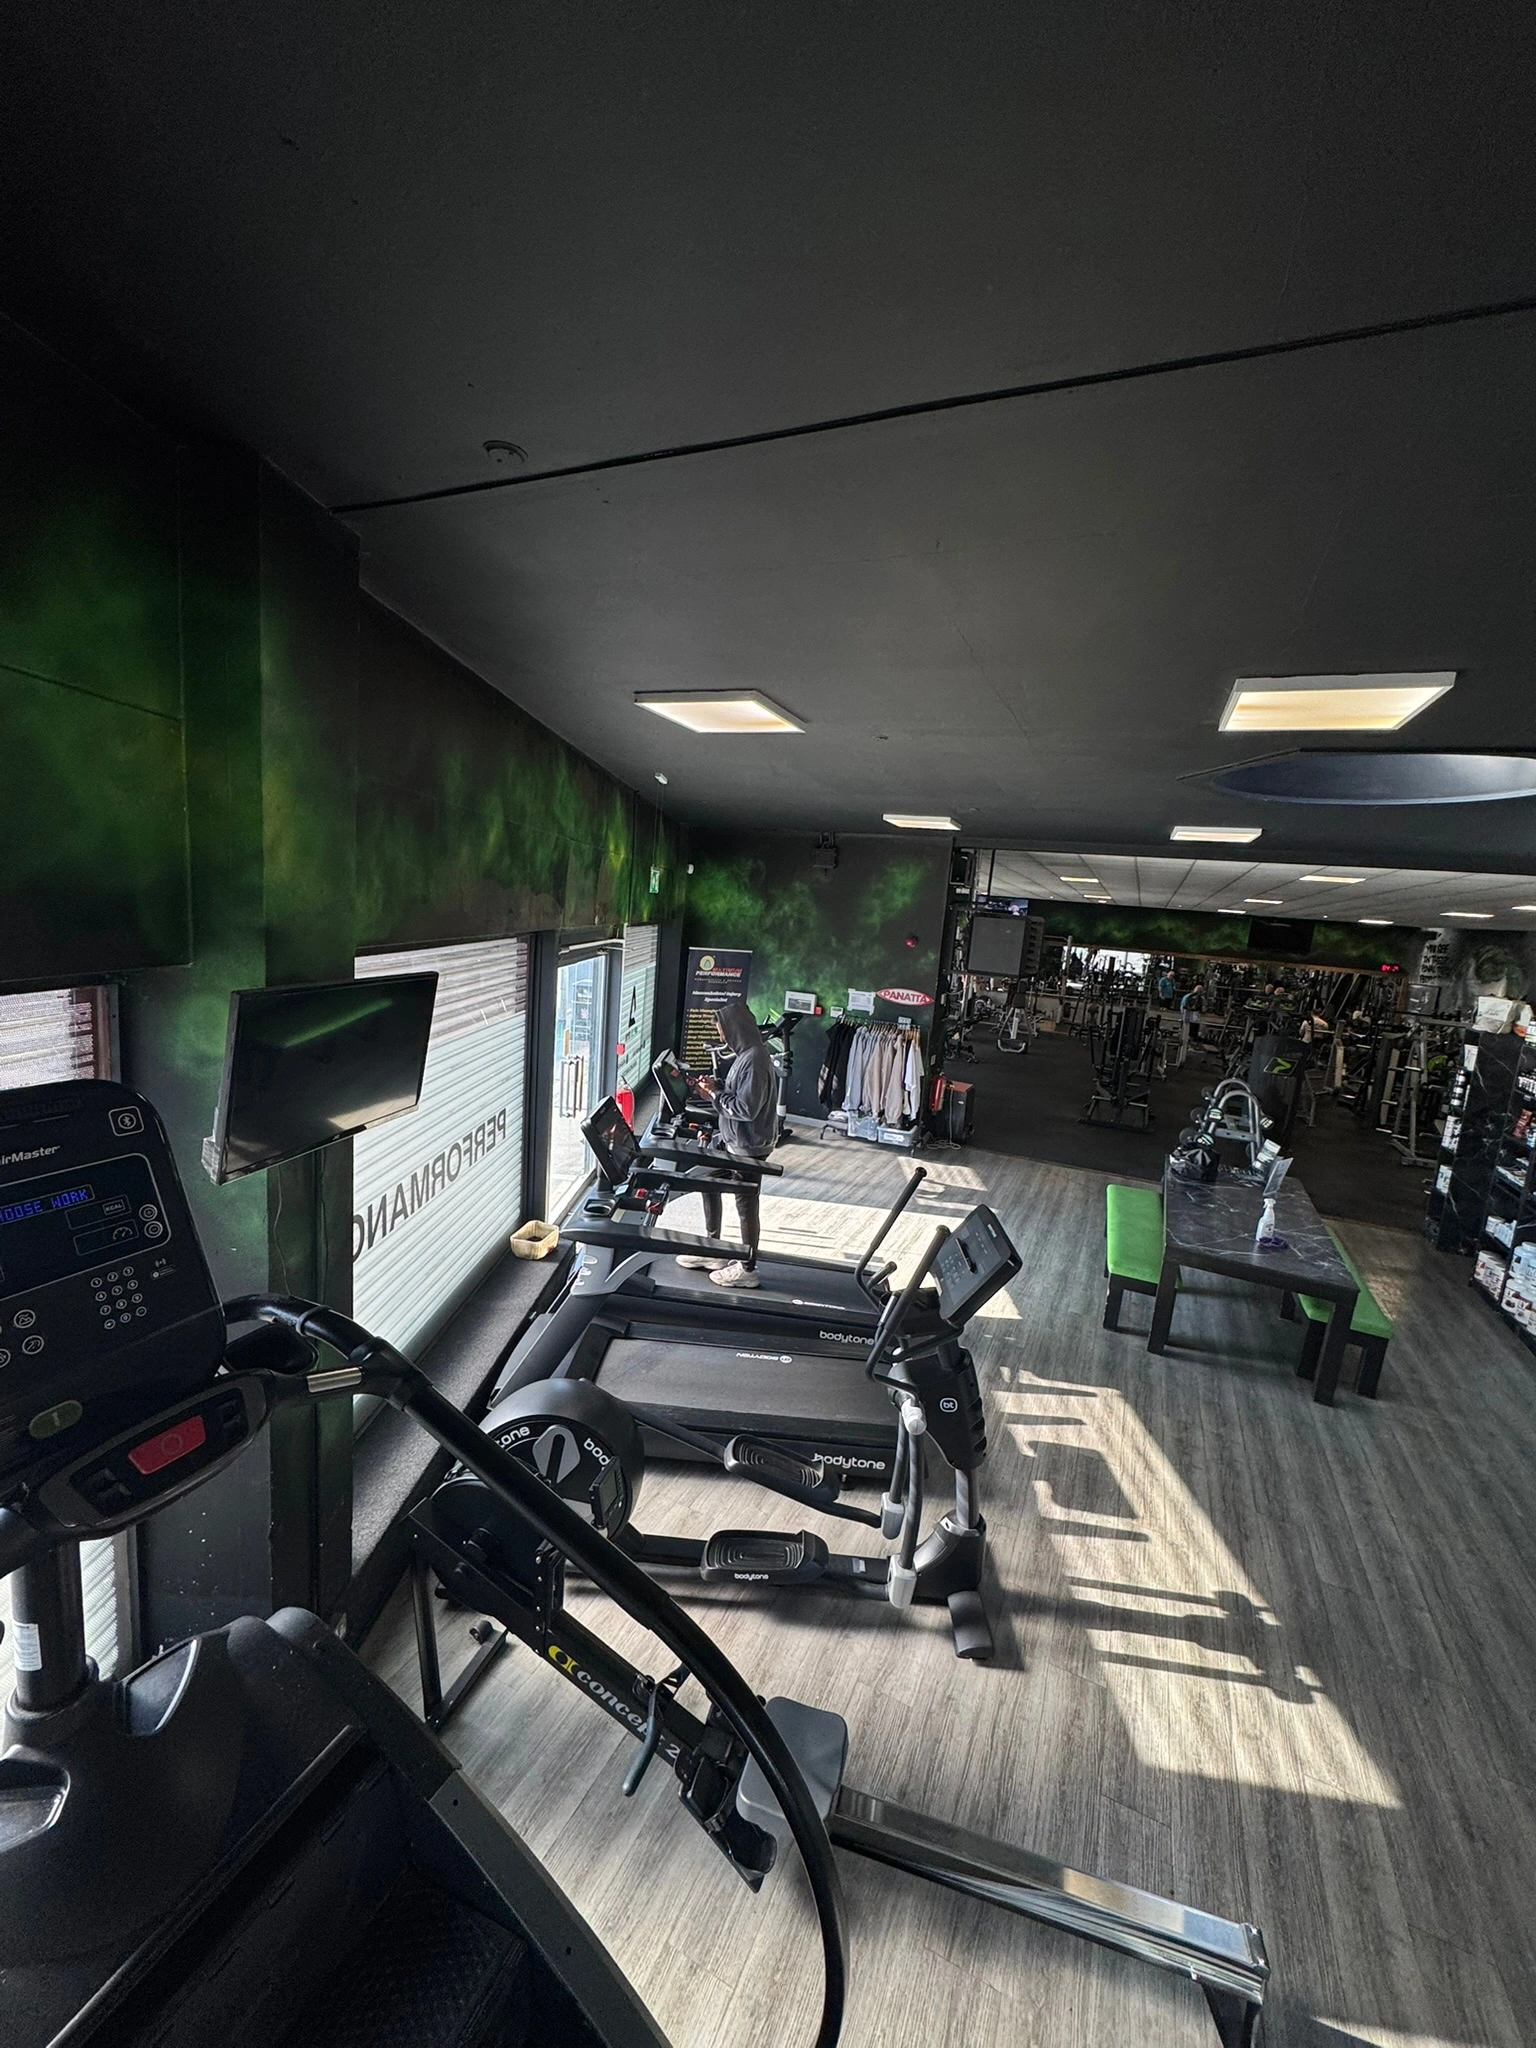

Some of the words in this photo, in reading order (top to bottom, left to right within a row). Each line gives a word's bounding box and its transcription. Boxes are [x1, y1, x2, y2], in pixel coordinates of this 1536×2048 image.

[883, 990, 927, 1004] PANATTA
[0, 1147, 58, 1166] irMaster
[51, 1189, 88, 1208] WORK
[819, 1330, 875, 1345] bodytone
[734, 1572, 770, 1581] bodytone
